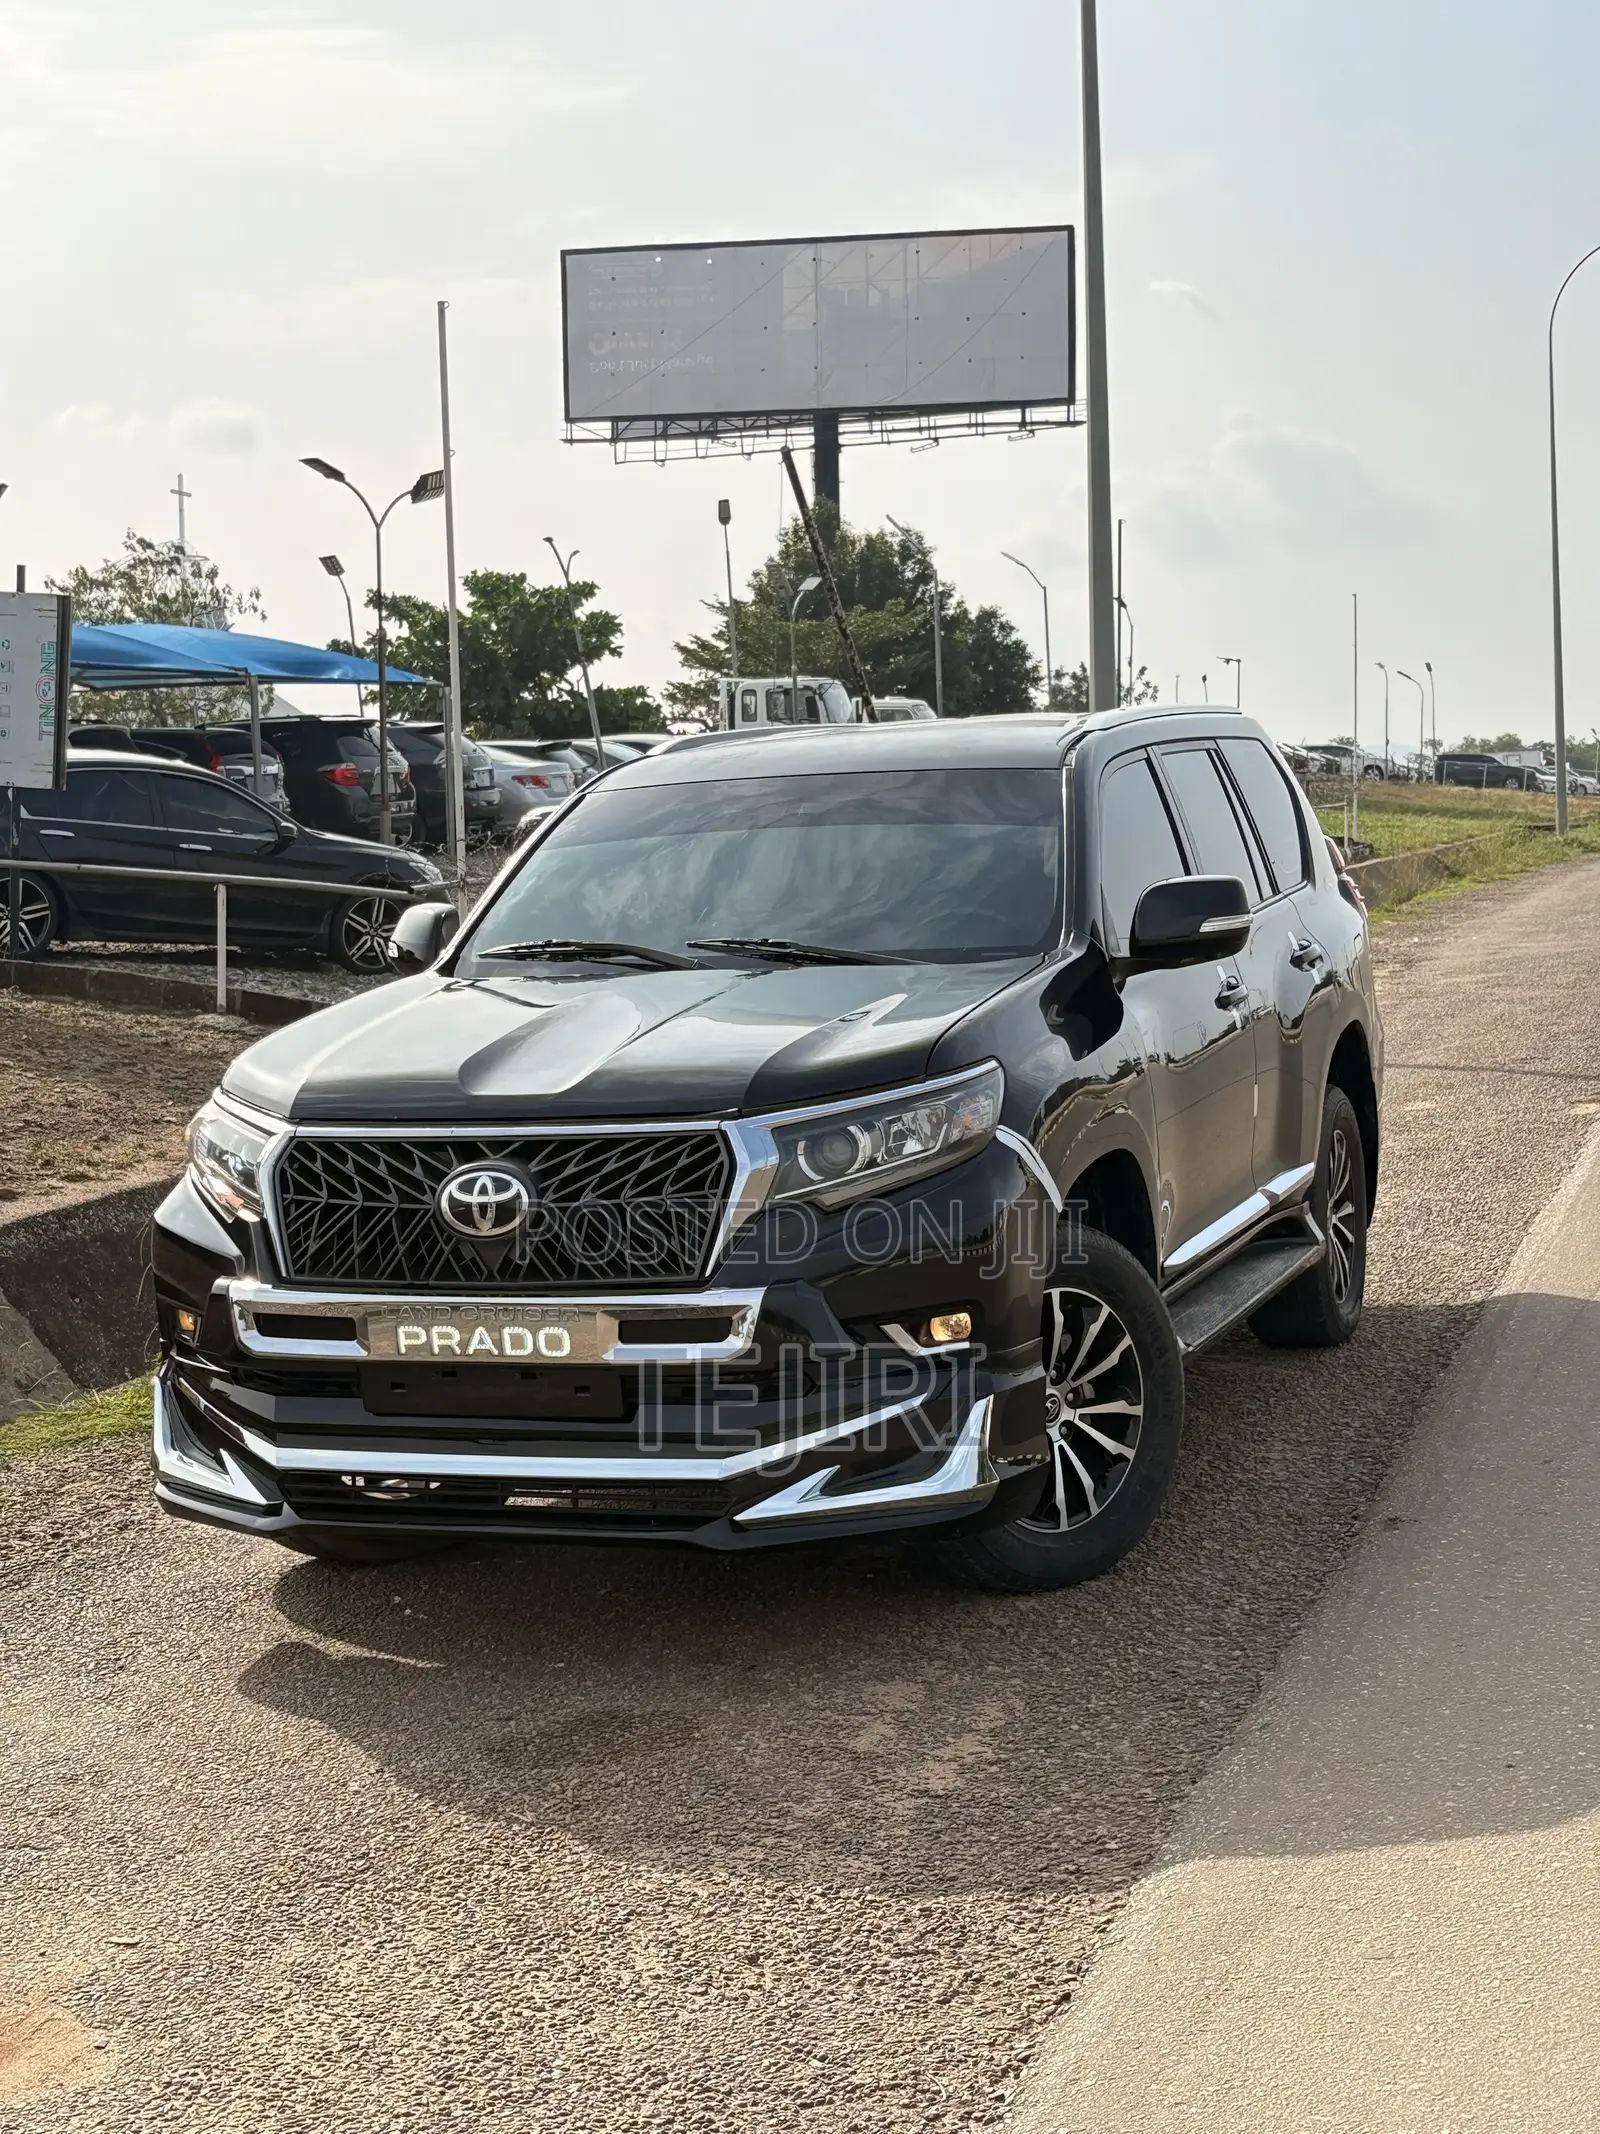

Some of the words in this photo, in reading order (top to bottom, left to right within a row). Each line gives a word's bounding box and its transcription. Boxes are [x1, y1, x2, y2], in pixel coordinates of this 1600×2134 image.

[382, 1305, 451, 1320] LAND
[459, 1306, 580, 1322] CRUISER
[397, 1325, 571, 1357] PRADO
